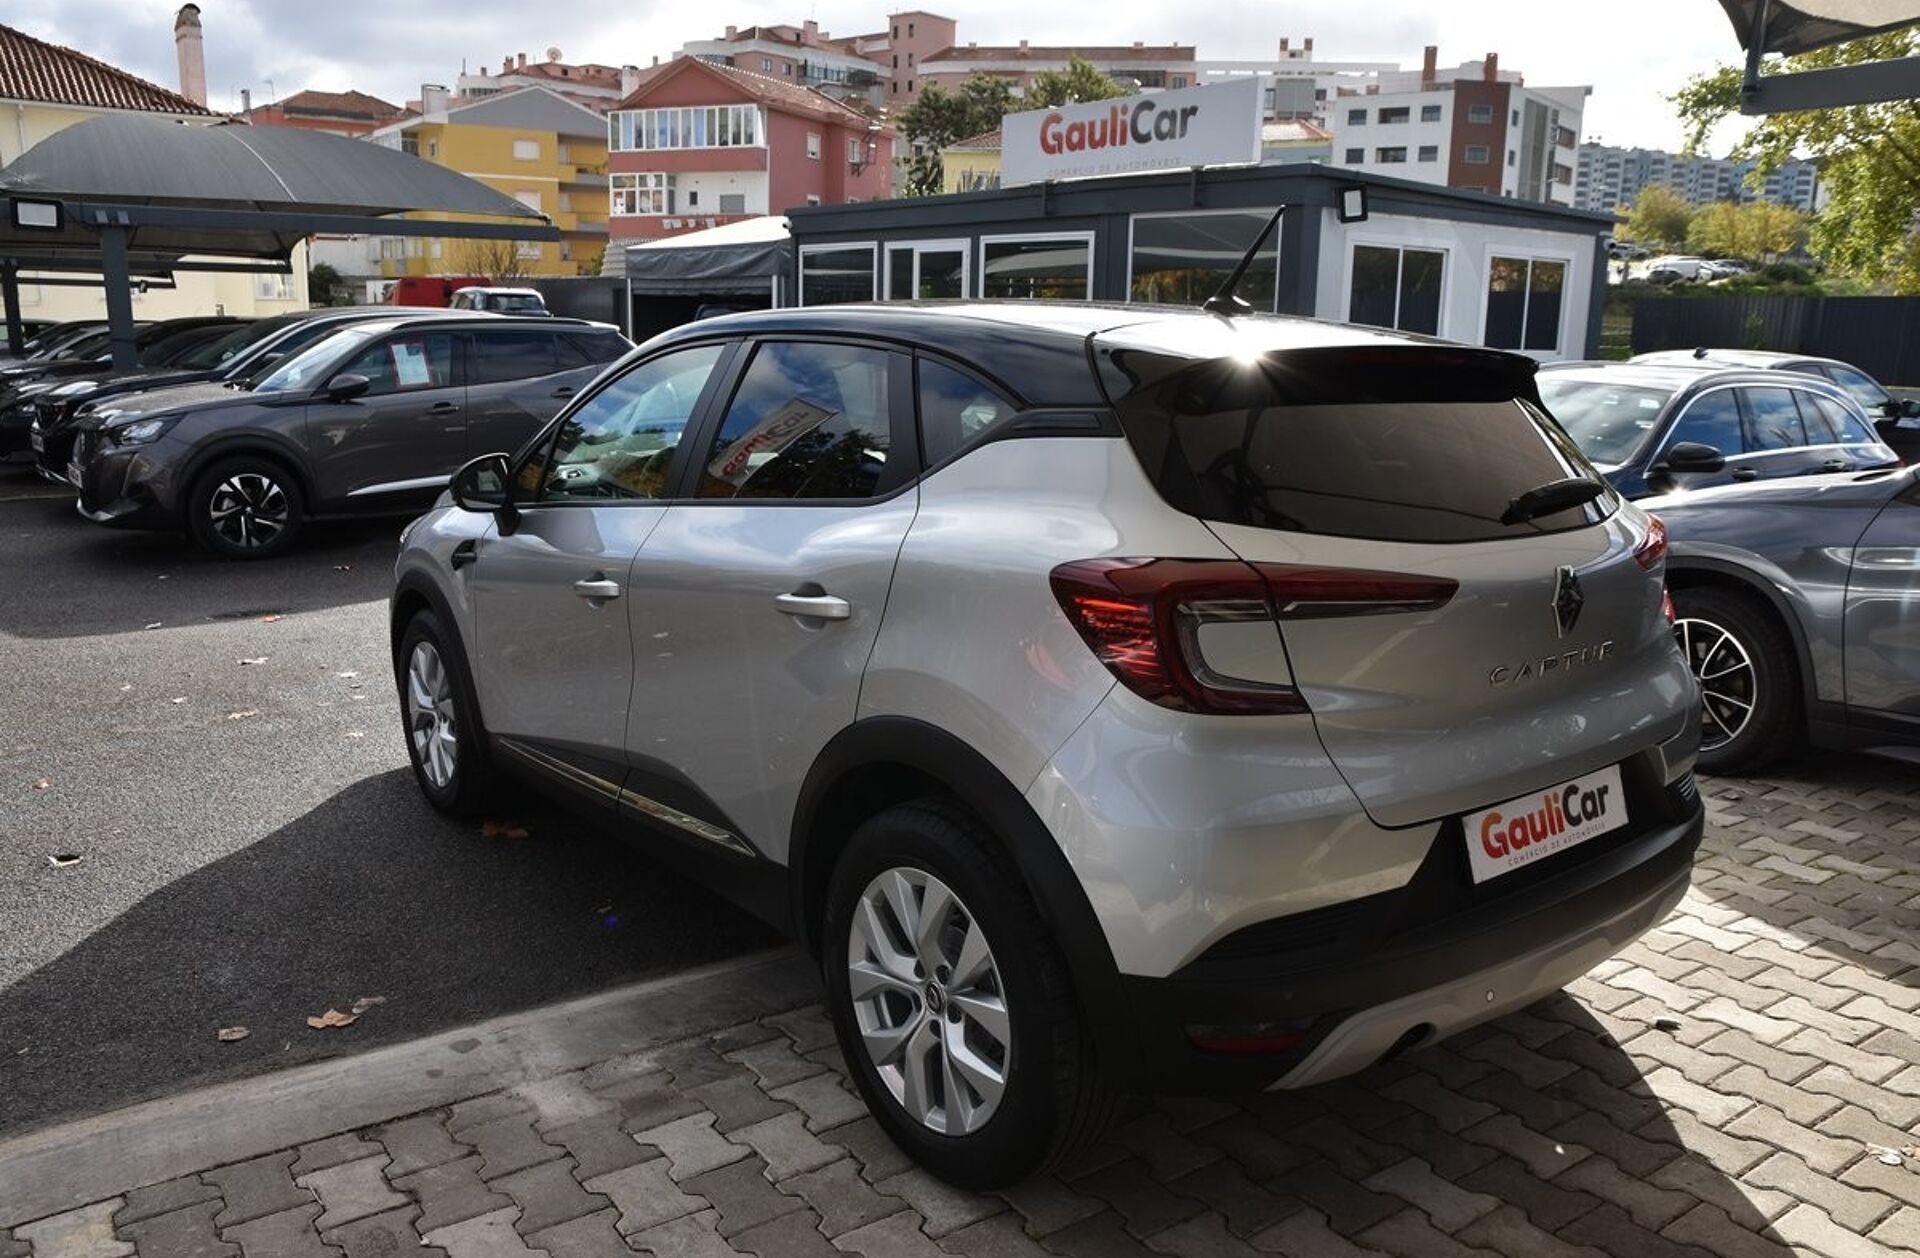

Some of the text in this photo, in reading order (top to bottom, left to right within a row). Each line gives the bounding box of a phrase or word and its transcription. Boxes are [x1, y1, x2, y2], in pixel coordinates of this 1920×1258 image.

[1040, 100, 1198, 154] GauliCar
[1490, 641, 1613, 685] CAPTUR
[1481, 784, 1609, 859] GauliCar
